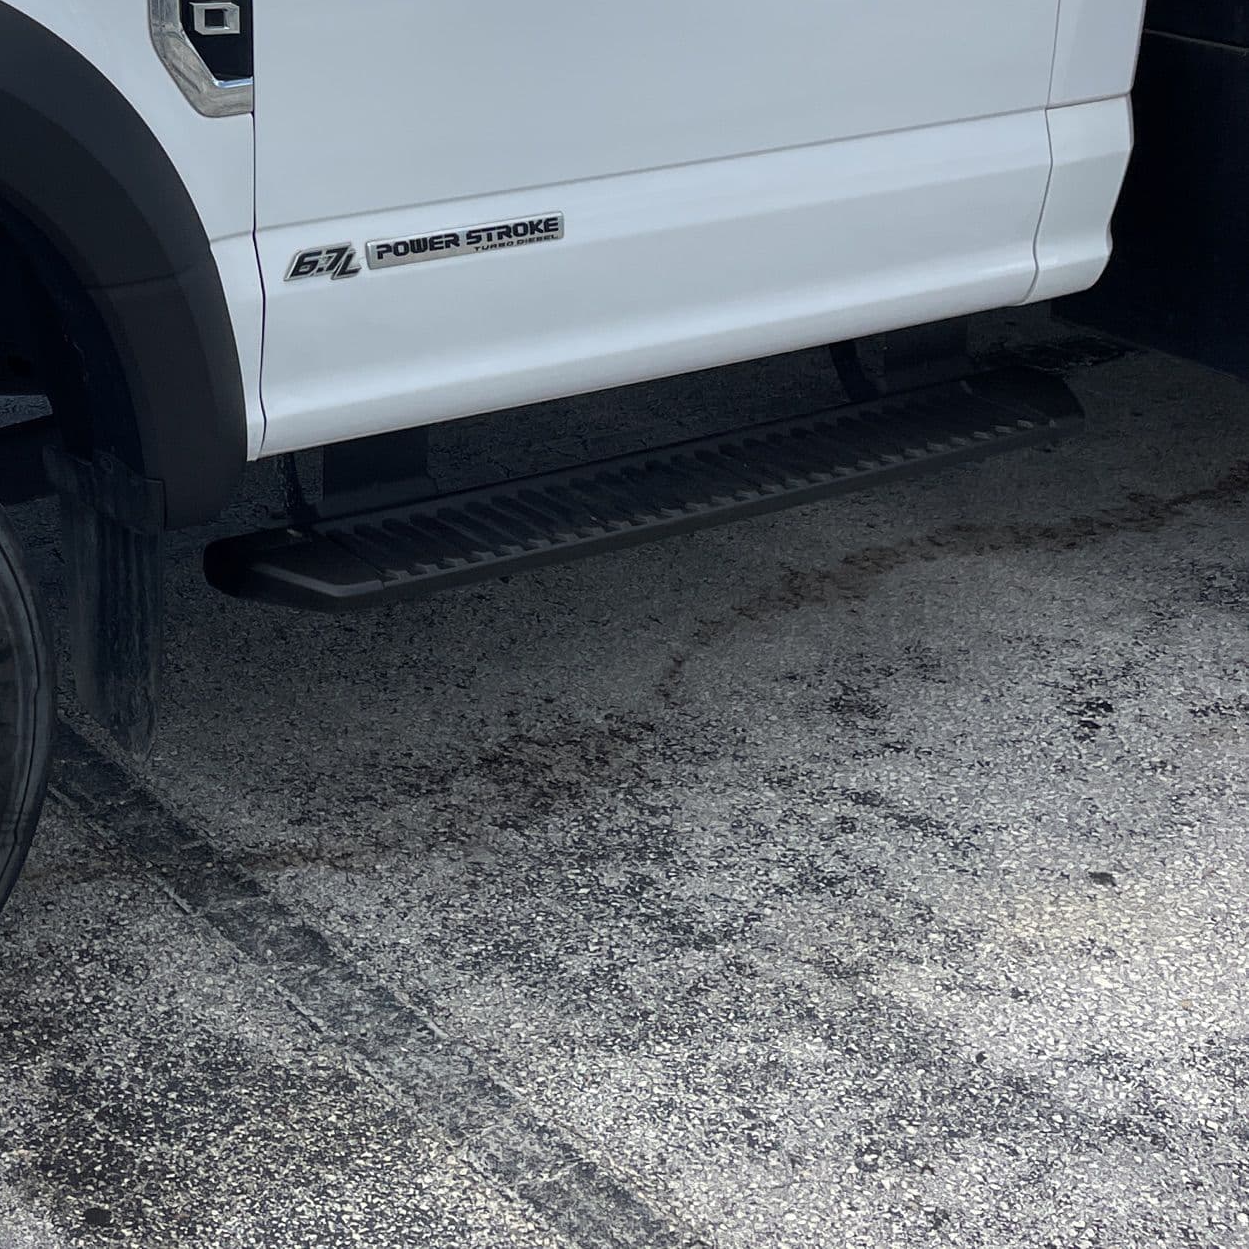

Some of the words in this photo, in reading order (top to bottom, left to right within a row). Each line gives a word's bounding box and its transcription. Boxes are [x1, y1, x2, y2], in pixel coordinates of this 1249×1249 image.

[284, 243, 362, 281] 6.7L
[376, 234, 461, 261] POWER
[465, 216, 559, 246] STROKE
[473, 240, 515, 252] TURBO
[516, 234, 560, 247] DIESEL
